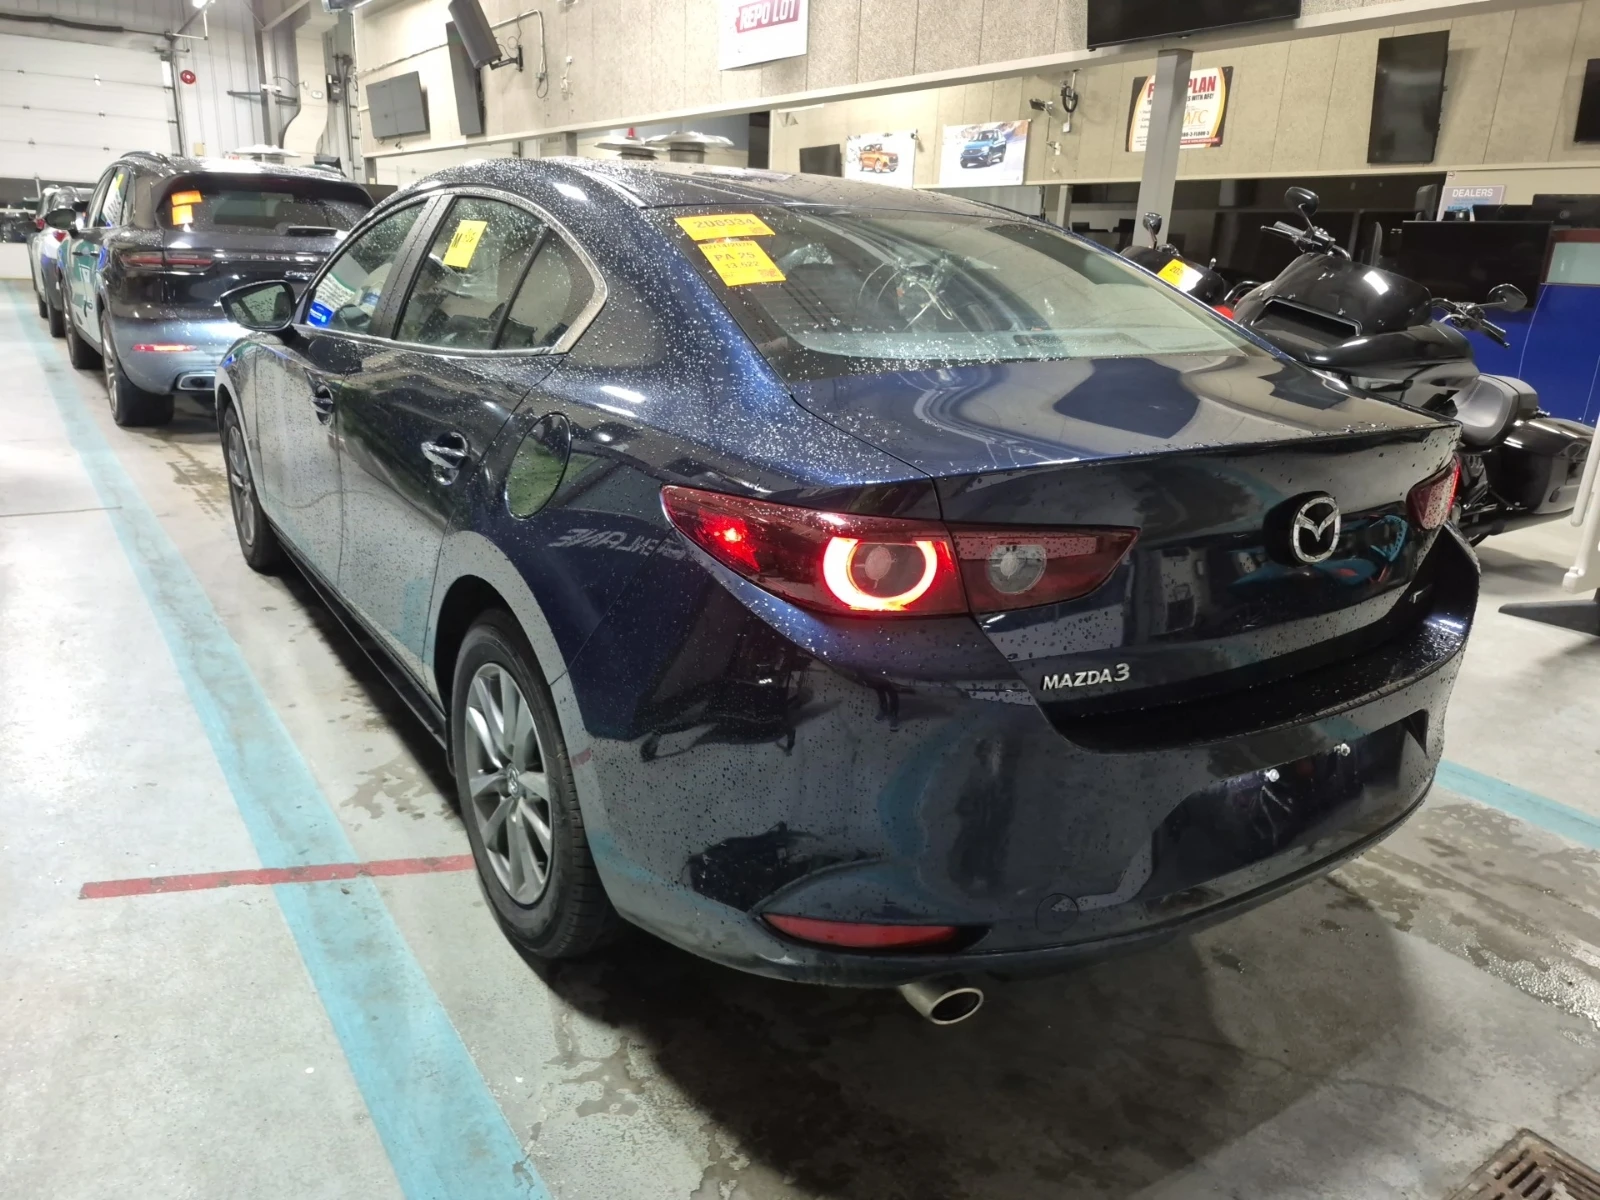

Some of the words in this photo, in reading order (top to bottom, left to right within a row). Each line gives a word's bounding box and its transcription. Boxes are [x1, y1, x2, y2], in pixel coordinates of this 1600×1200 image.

[740, 1, 771, 31] REPO
[772, 0, 797, 22] LOT
[1452, 188, 1494, 198] DEALERS
